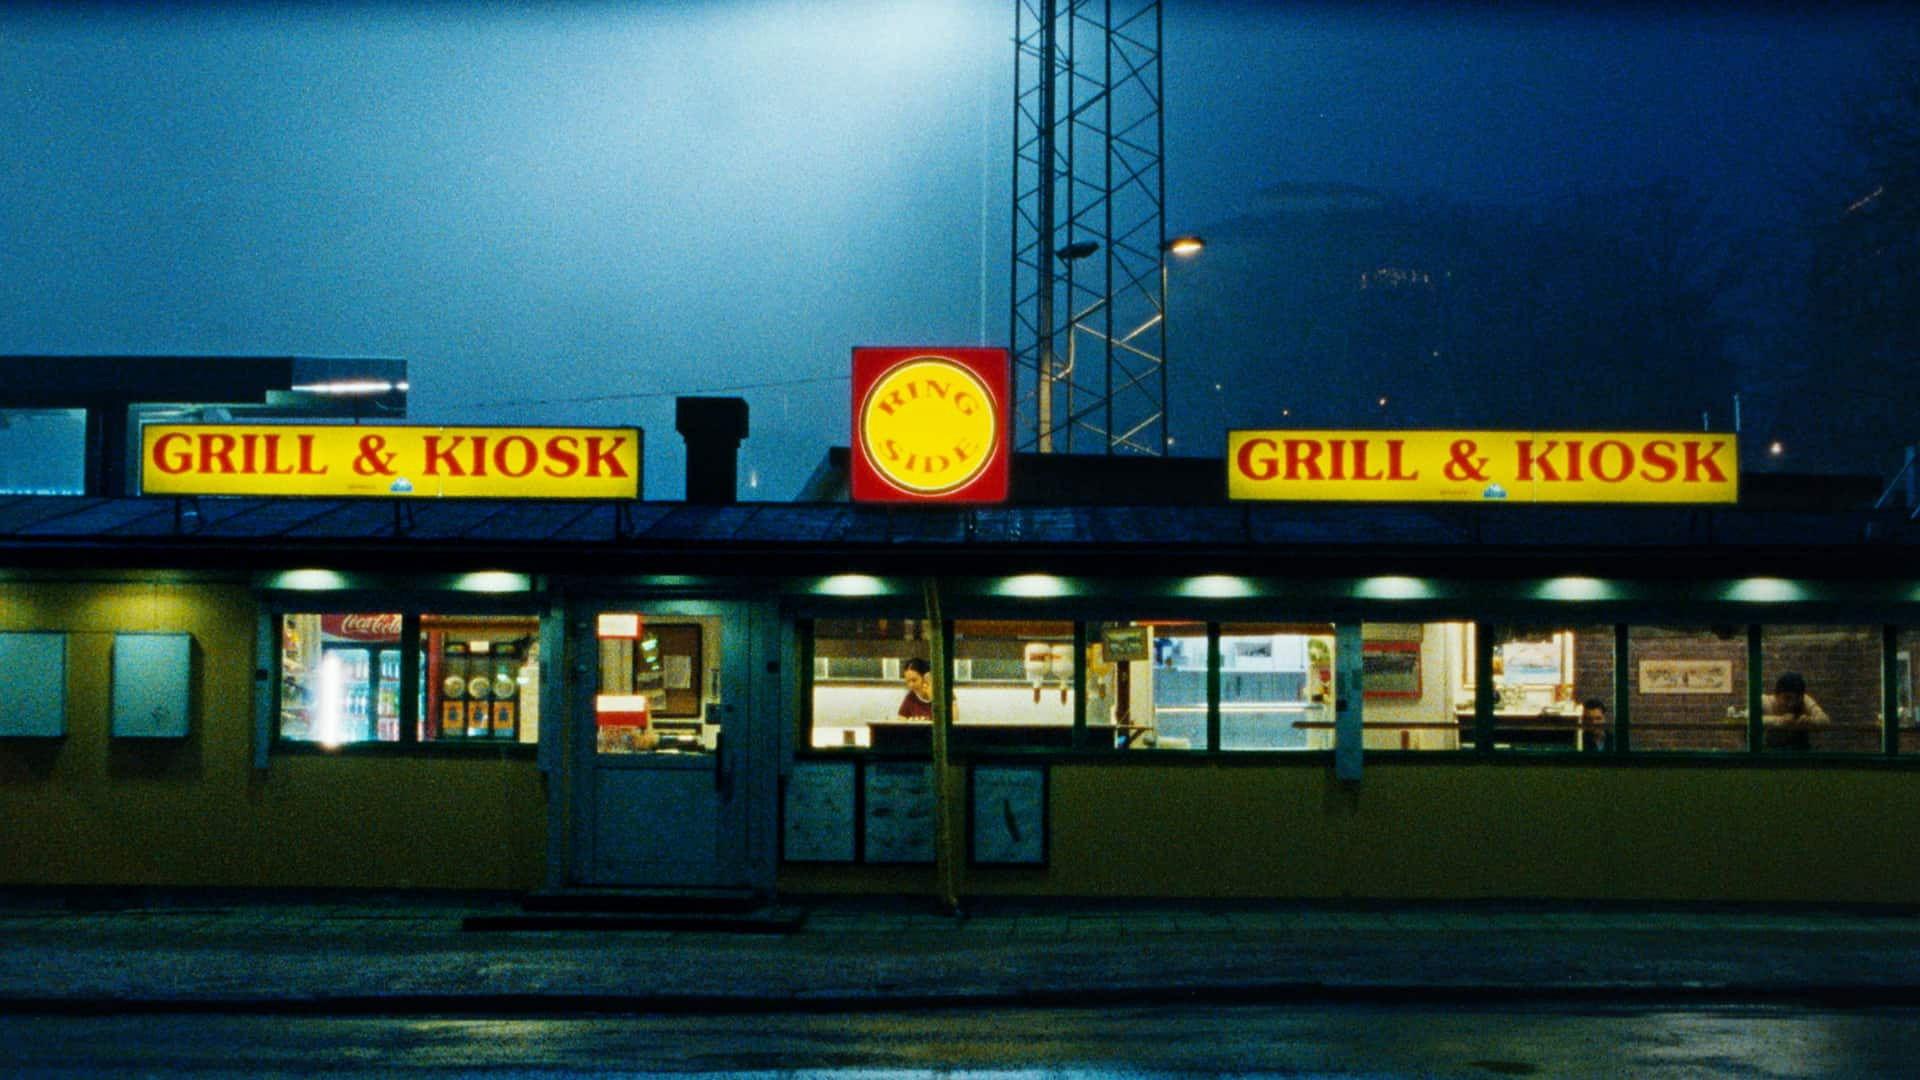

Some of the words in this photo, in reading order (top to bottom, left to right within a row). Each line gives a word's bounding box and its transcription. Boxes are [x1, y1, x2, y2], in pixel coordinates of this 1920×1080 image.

[878, 379, 980, 417] RING
[152, 433, 328, 476] GRILL
[353, 434, 396, 478] &
[424, 435, 629, 479] KIOSK
[879, 436, 979, 472] SIDE
[1237, 439, 1419, 482] GRILL
[1443, 439, 1489, 484] &
[1516, 440, 1727, 484] KIOSK
